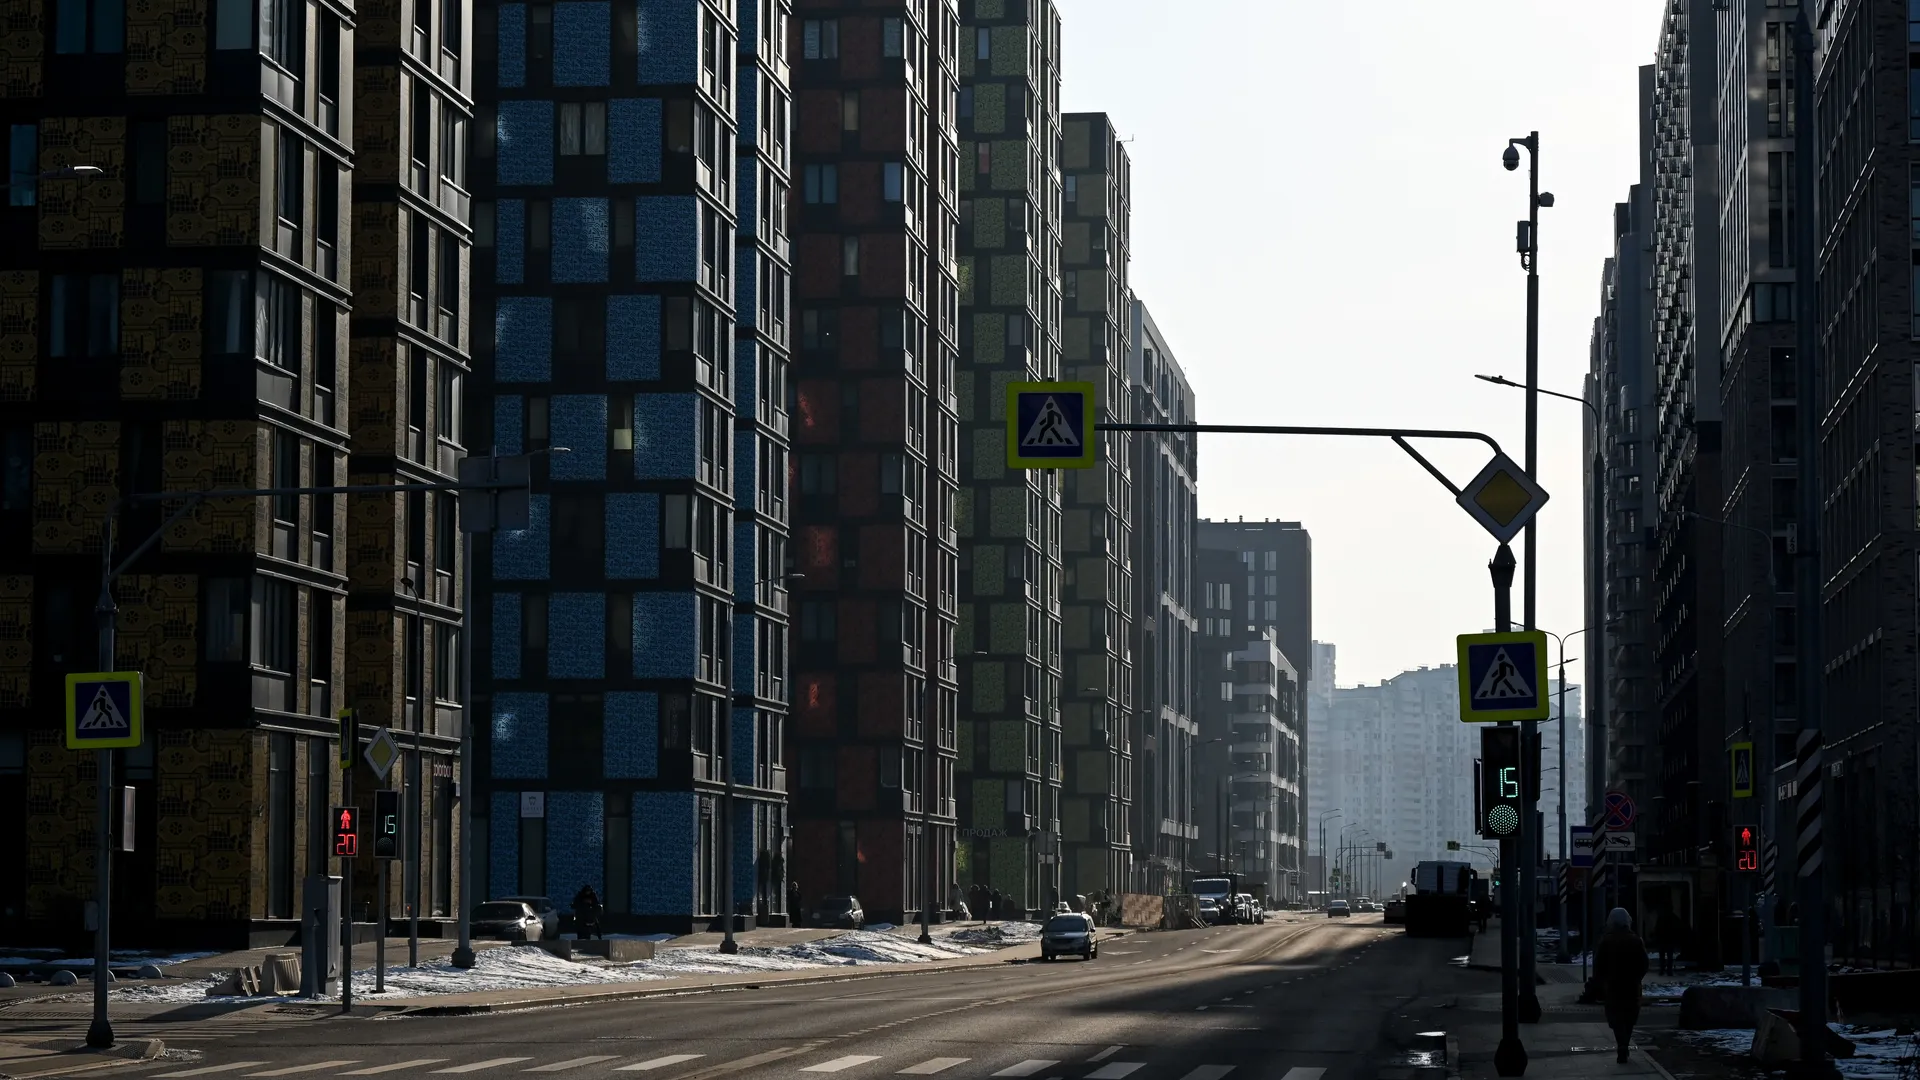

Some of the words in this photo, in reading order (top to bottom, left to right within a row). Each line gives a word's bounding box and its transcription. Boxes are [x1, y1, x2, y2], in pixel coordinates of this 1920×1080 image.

[1500, 767, 1518, 798] 15
[384, 815, 396, 834] 15
[962, 828, 1008, 839] ПРОДАЖ
[336, 834, 356, 855] 20
[1738, 850, 1757, 870] 20
